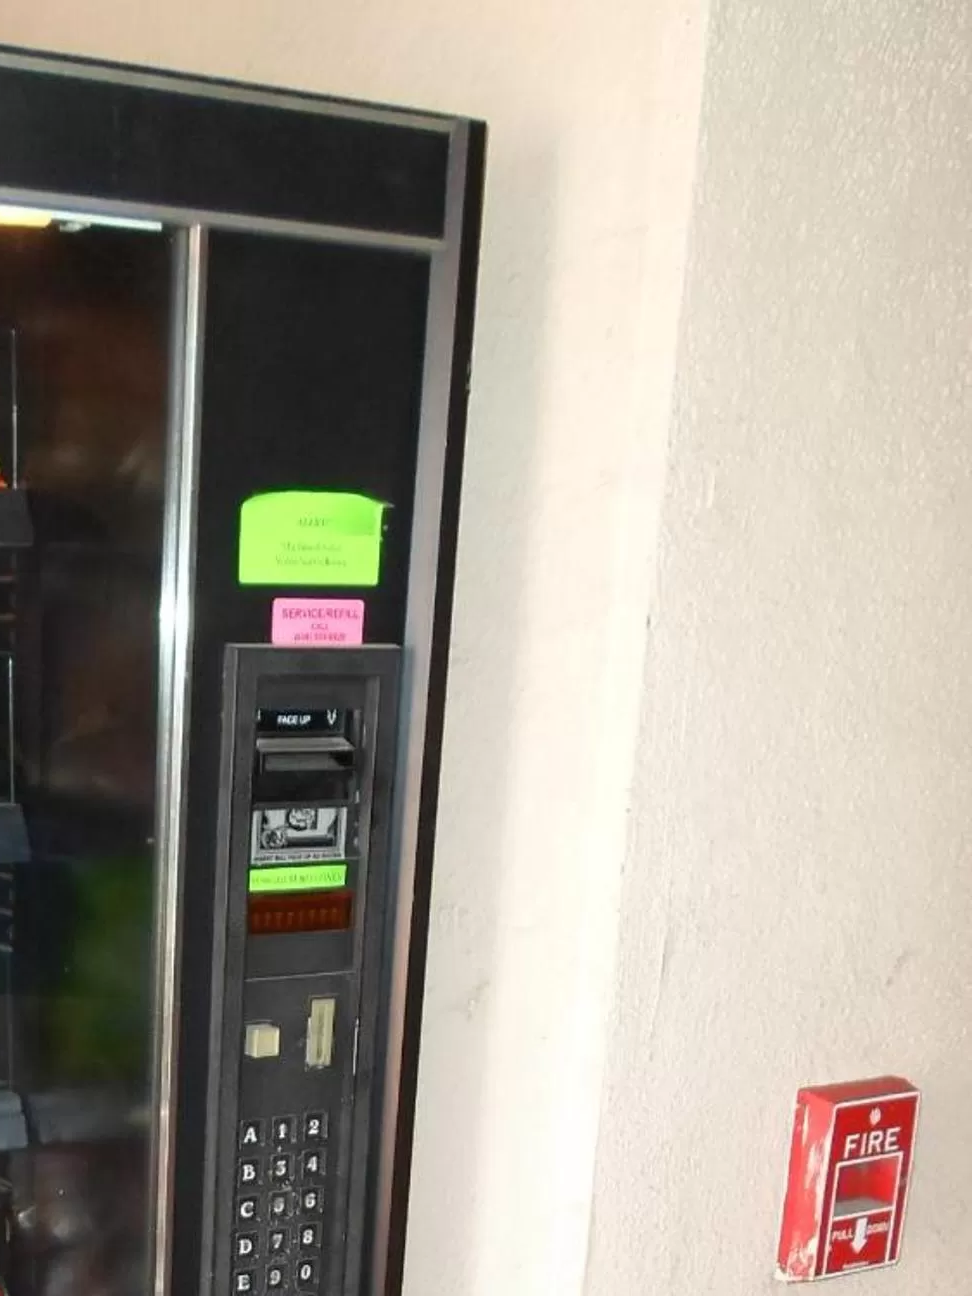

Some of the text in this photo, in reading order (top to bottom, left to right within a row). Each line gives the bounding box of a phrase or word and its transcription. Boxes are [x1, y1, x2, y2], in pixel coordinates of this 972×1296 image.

[277, 714, 312, 725] FACE UP
[244, 1119, 320, 1144] A 1 2
[843, 1126, 902, 1160] FIRE
[242, 1155, 318, 1181] B 3 4
[240, 1192, 316, 1218] C 5 6
[238, 1229, 313, 1255] D 7 8
[237, 1264, 311, 1291] E 9 0
